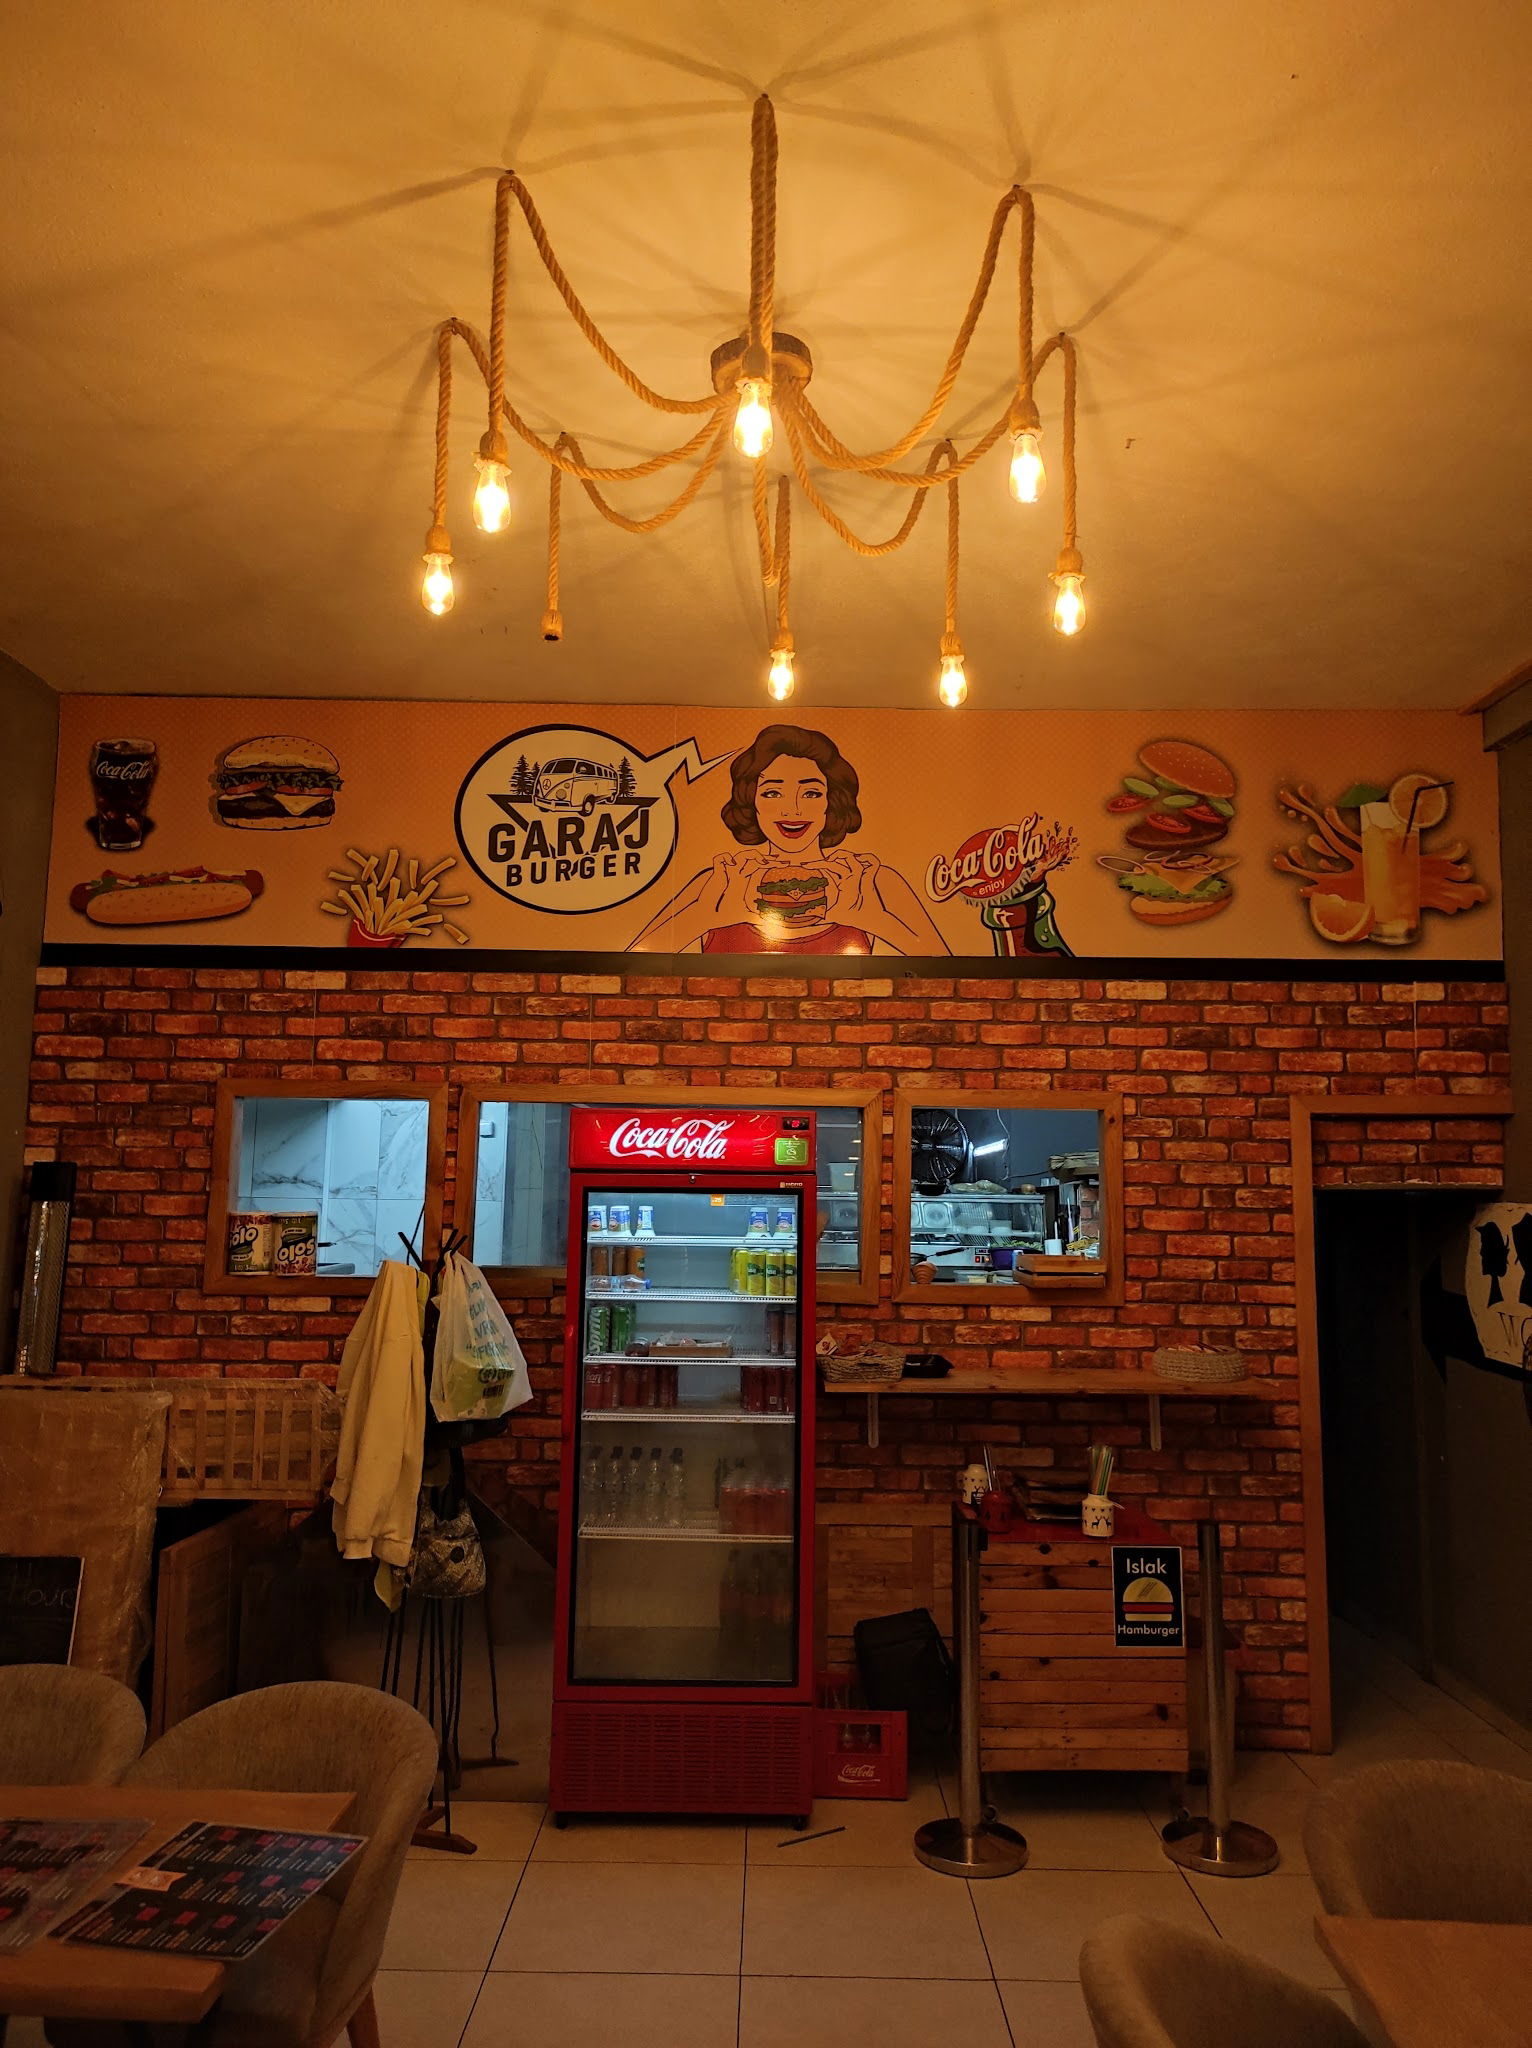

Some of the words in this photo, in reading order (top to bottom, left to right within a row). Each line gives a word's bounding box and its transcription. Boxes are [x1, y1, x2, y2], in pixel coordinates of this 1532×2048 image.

[487, 808, 649, 863] GARAJ
[505, 852, 641, 887] BURGER
[925, 812, 1044, 903] Coca-Cola
[978, 877, 1005, 895] enjoy
[609, 1118, 735, 1159] Coca-Cola
[1125, 1557, 1168, 1576] Islak
[1116, 1623, 1180, 1637] Hamburger
